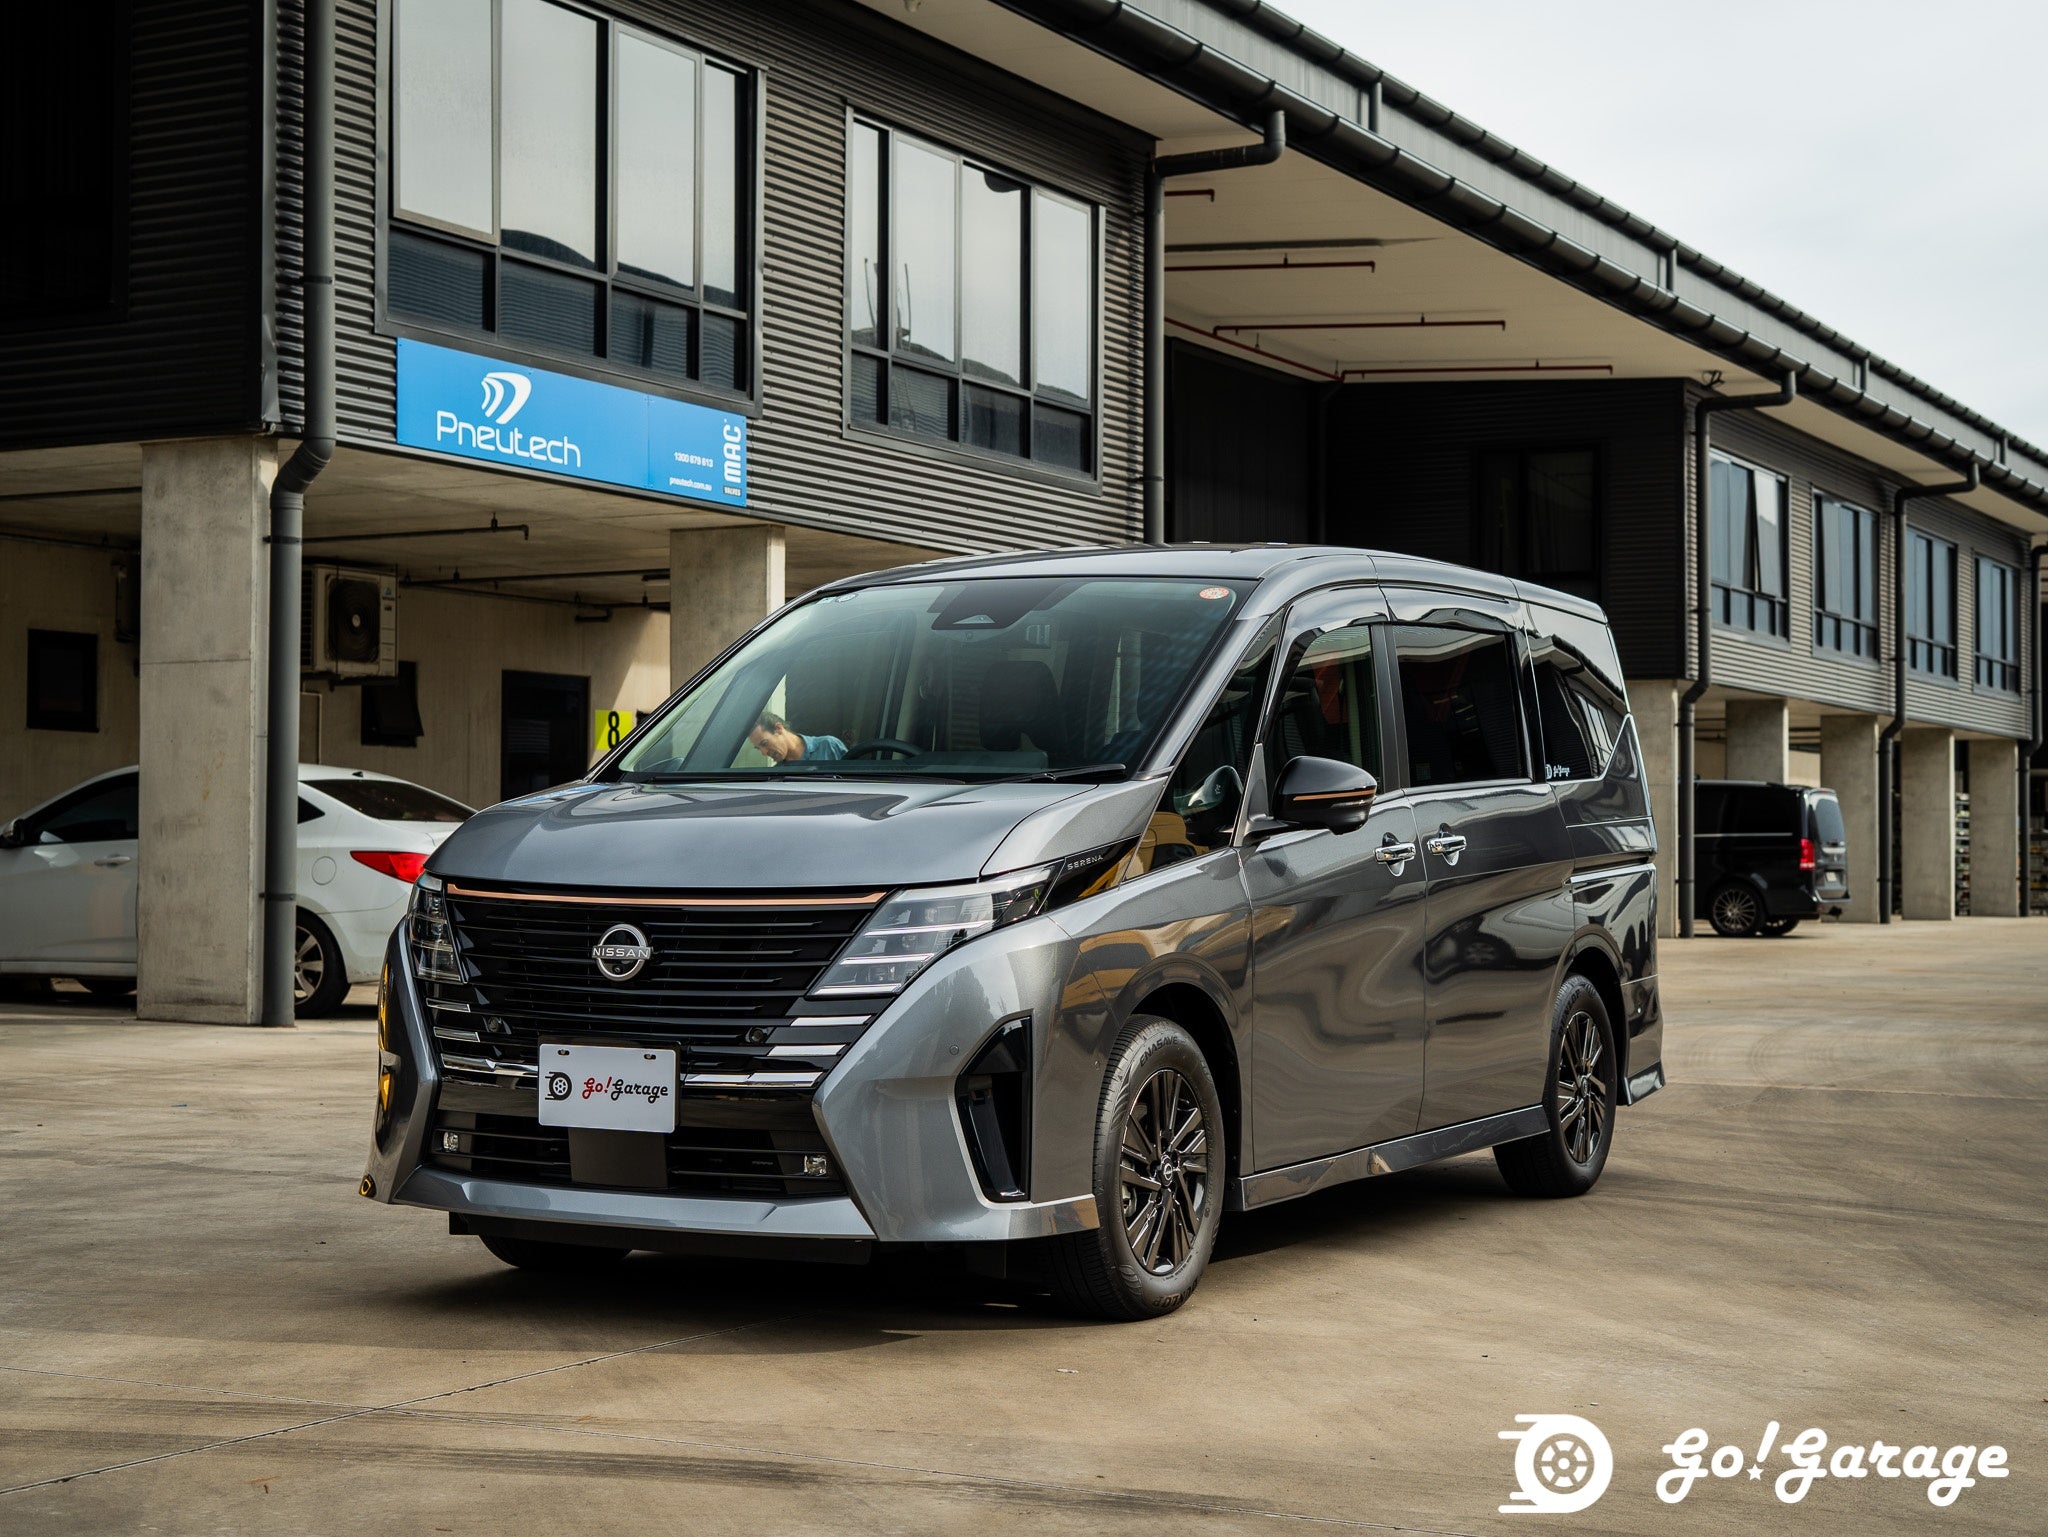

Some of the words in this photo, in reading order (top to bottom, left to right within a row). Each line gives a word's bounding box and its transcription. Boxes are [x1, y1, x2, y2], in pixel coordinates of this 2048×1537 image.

[436, 410, 581, 468] Pneutech
[608, 711, 620, 750] 8
[1067, 854, 1104, 871] SERENA
[592, 946, 651, 959] NISSAN
